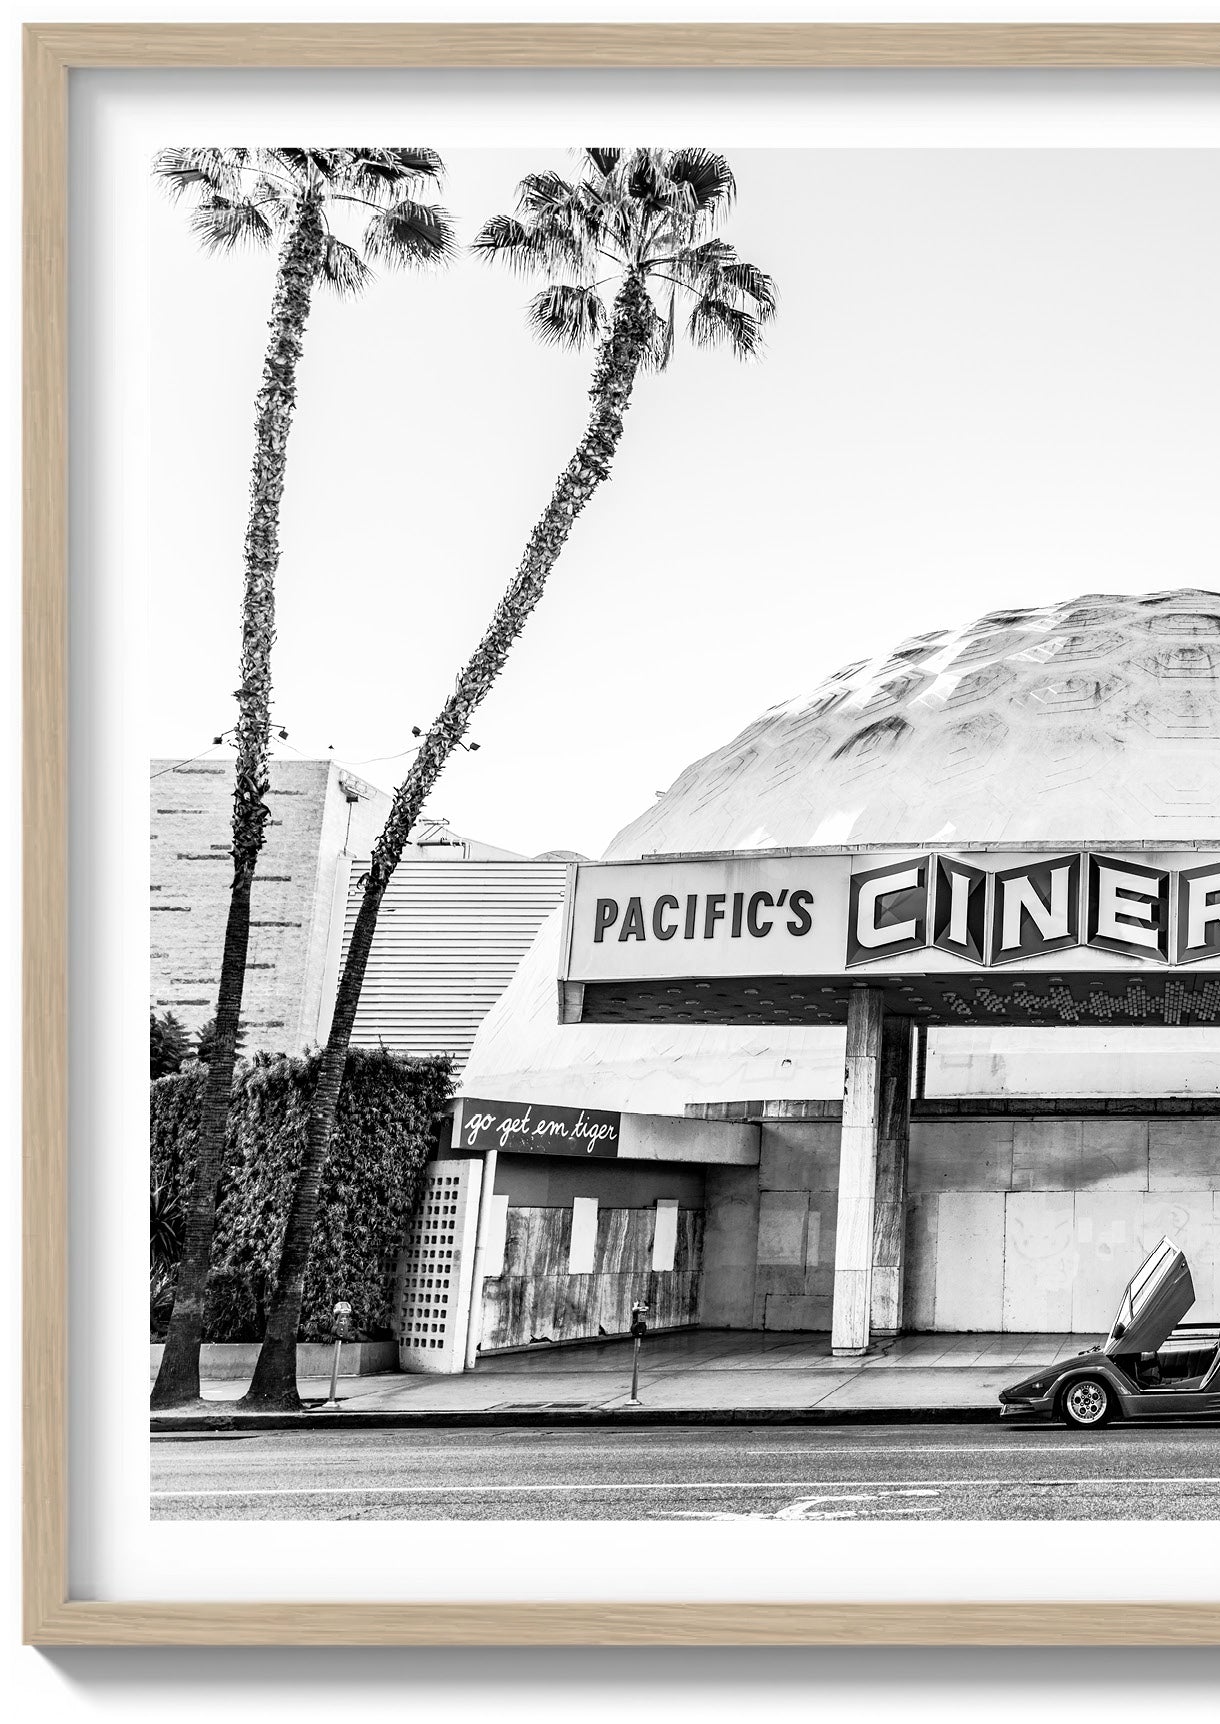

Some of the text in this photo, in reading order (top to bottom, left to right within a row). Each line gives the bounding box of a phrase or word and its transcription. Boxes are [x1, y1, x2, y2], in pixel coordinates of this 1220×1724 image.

[593, 888, 814, 943] PACIFIC'S
[465, 1105, 617, 1153] go get em tiger
